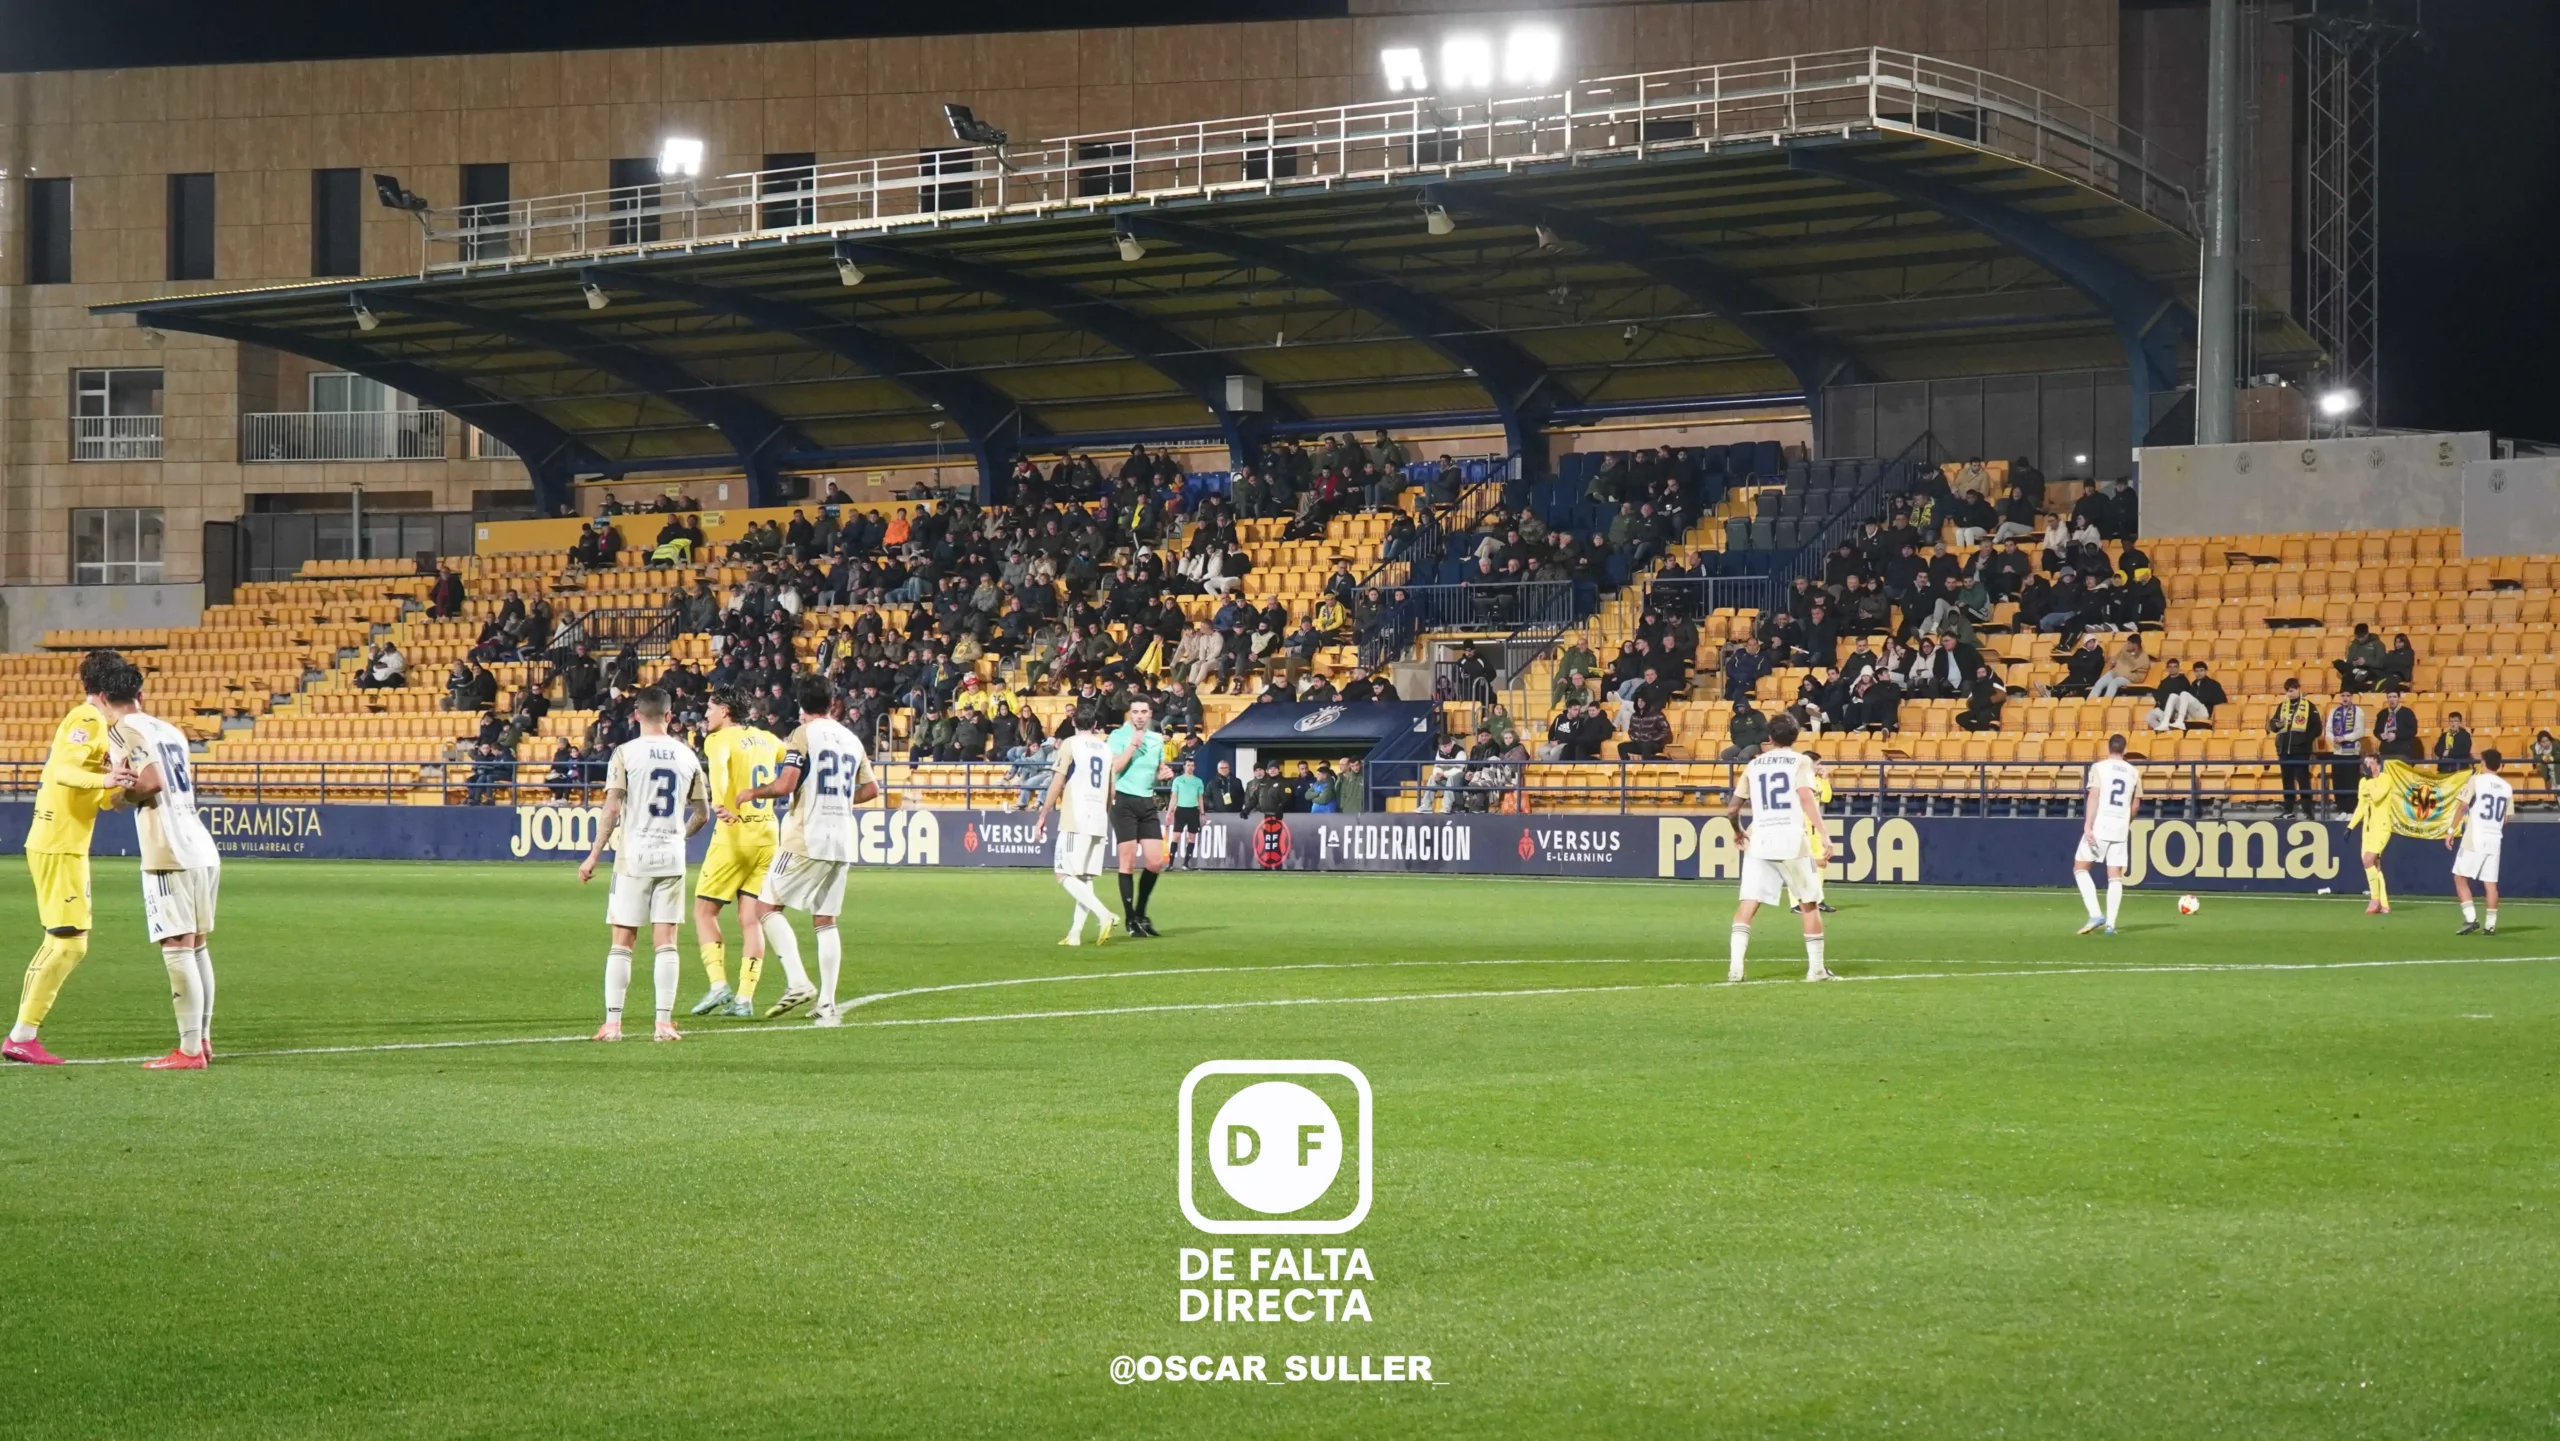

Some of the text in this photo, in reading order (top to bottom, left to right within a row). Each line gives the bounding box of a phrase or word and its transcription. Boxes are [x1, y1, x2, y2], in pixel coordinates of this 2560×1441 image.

[751, 764, 769, 810] 6
[817, 749, 857, 798] 23
[1090, 755, 1103, 788] 8
[648, 767, 677, 818] 3
[1758, 771, 1792, 811] 12
[2109, 778, 2126, 807] 2
[2479, 793, 2507, 823] 30
[217, 841, 305, 852] CLUB VILLARREAL CF
[978, 824, 1048, 844] VERSUS
[987, 844, 1041, 855] E-LEARNING
[1343, 820, 1471, 861] FEDERACIÓN
[1536, 829, 1621, 852] VERSUS
[1658, 816, 1920, 882] PAESA
[1546, 852, 1613, 863] E-LEARNING
